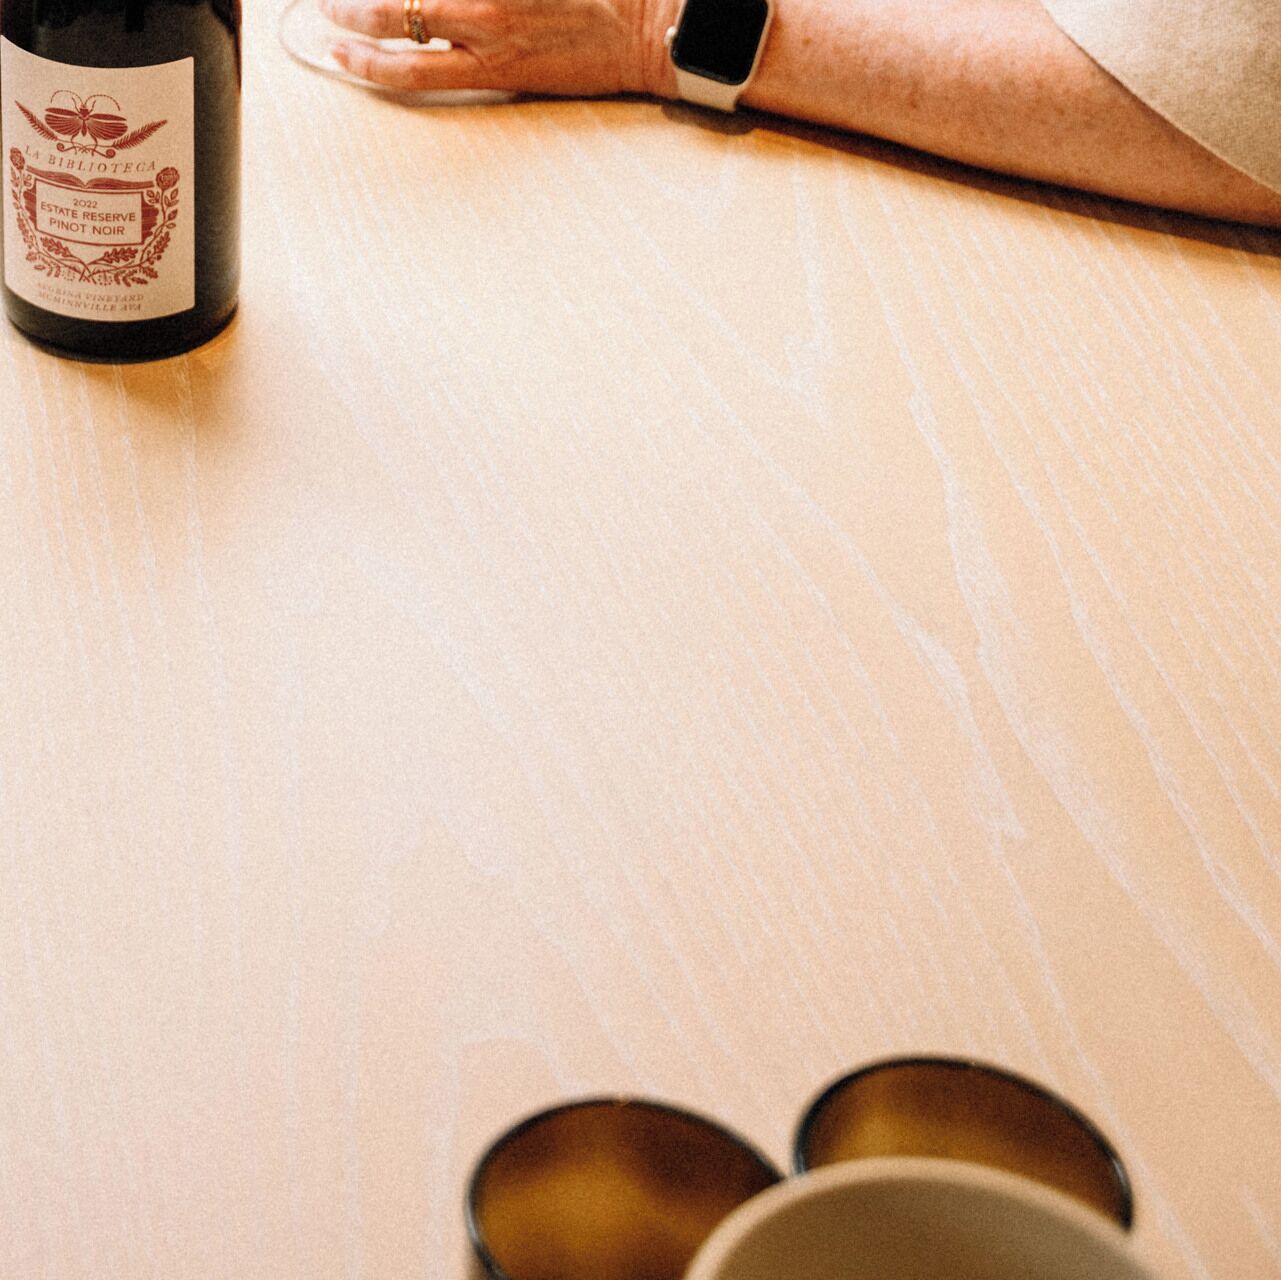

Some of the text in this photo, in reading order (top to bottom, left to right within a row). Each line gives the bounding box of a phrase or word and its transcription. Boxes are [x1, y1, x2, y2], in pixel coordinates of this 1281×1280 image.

[25, 145, 156, 174] LA BIBLIOTECA
[40, 201, 137, 222] ESTATE RESERVE
[73, 198, 98, 209] 2022
[49, 217, 126, 236] PINOT NOIR
[86, 293, 145, 303] VINEYARD
